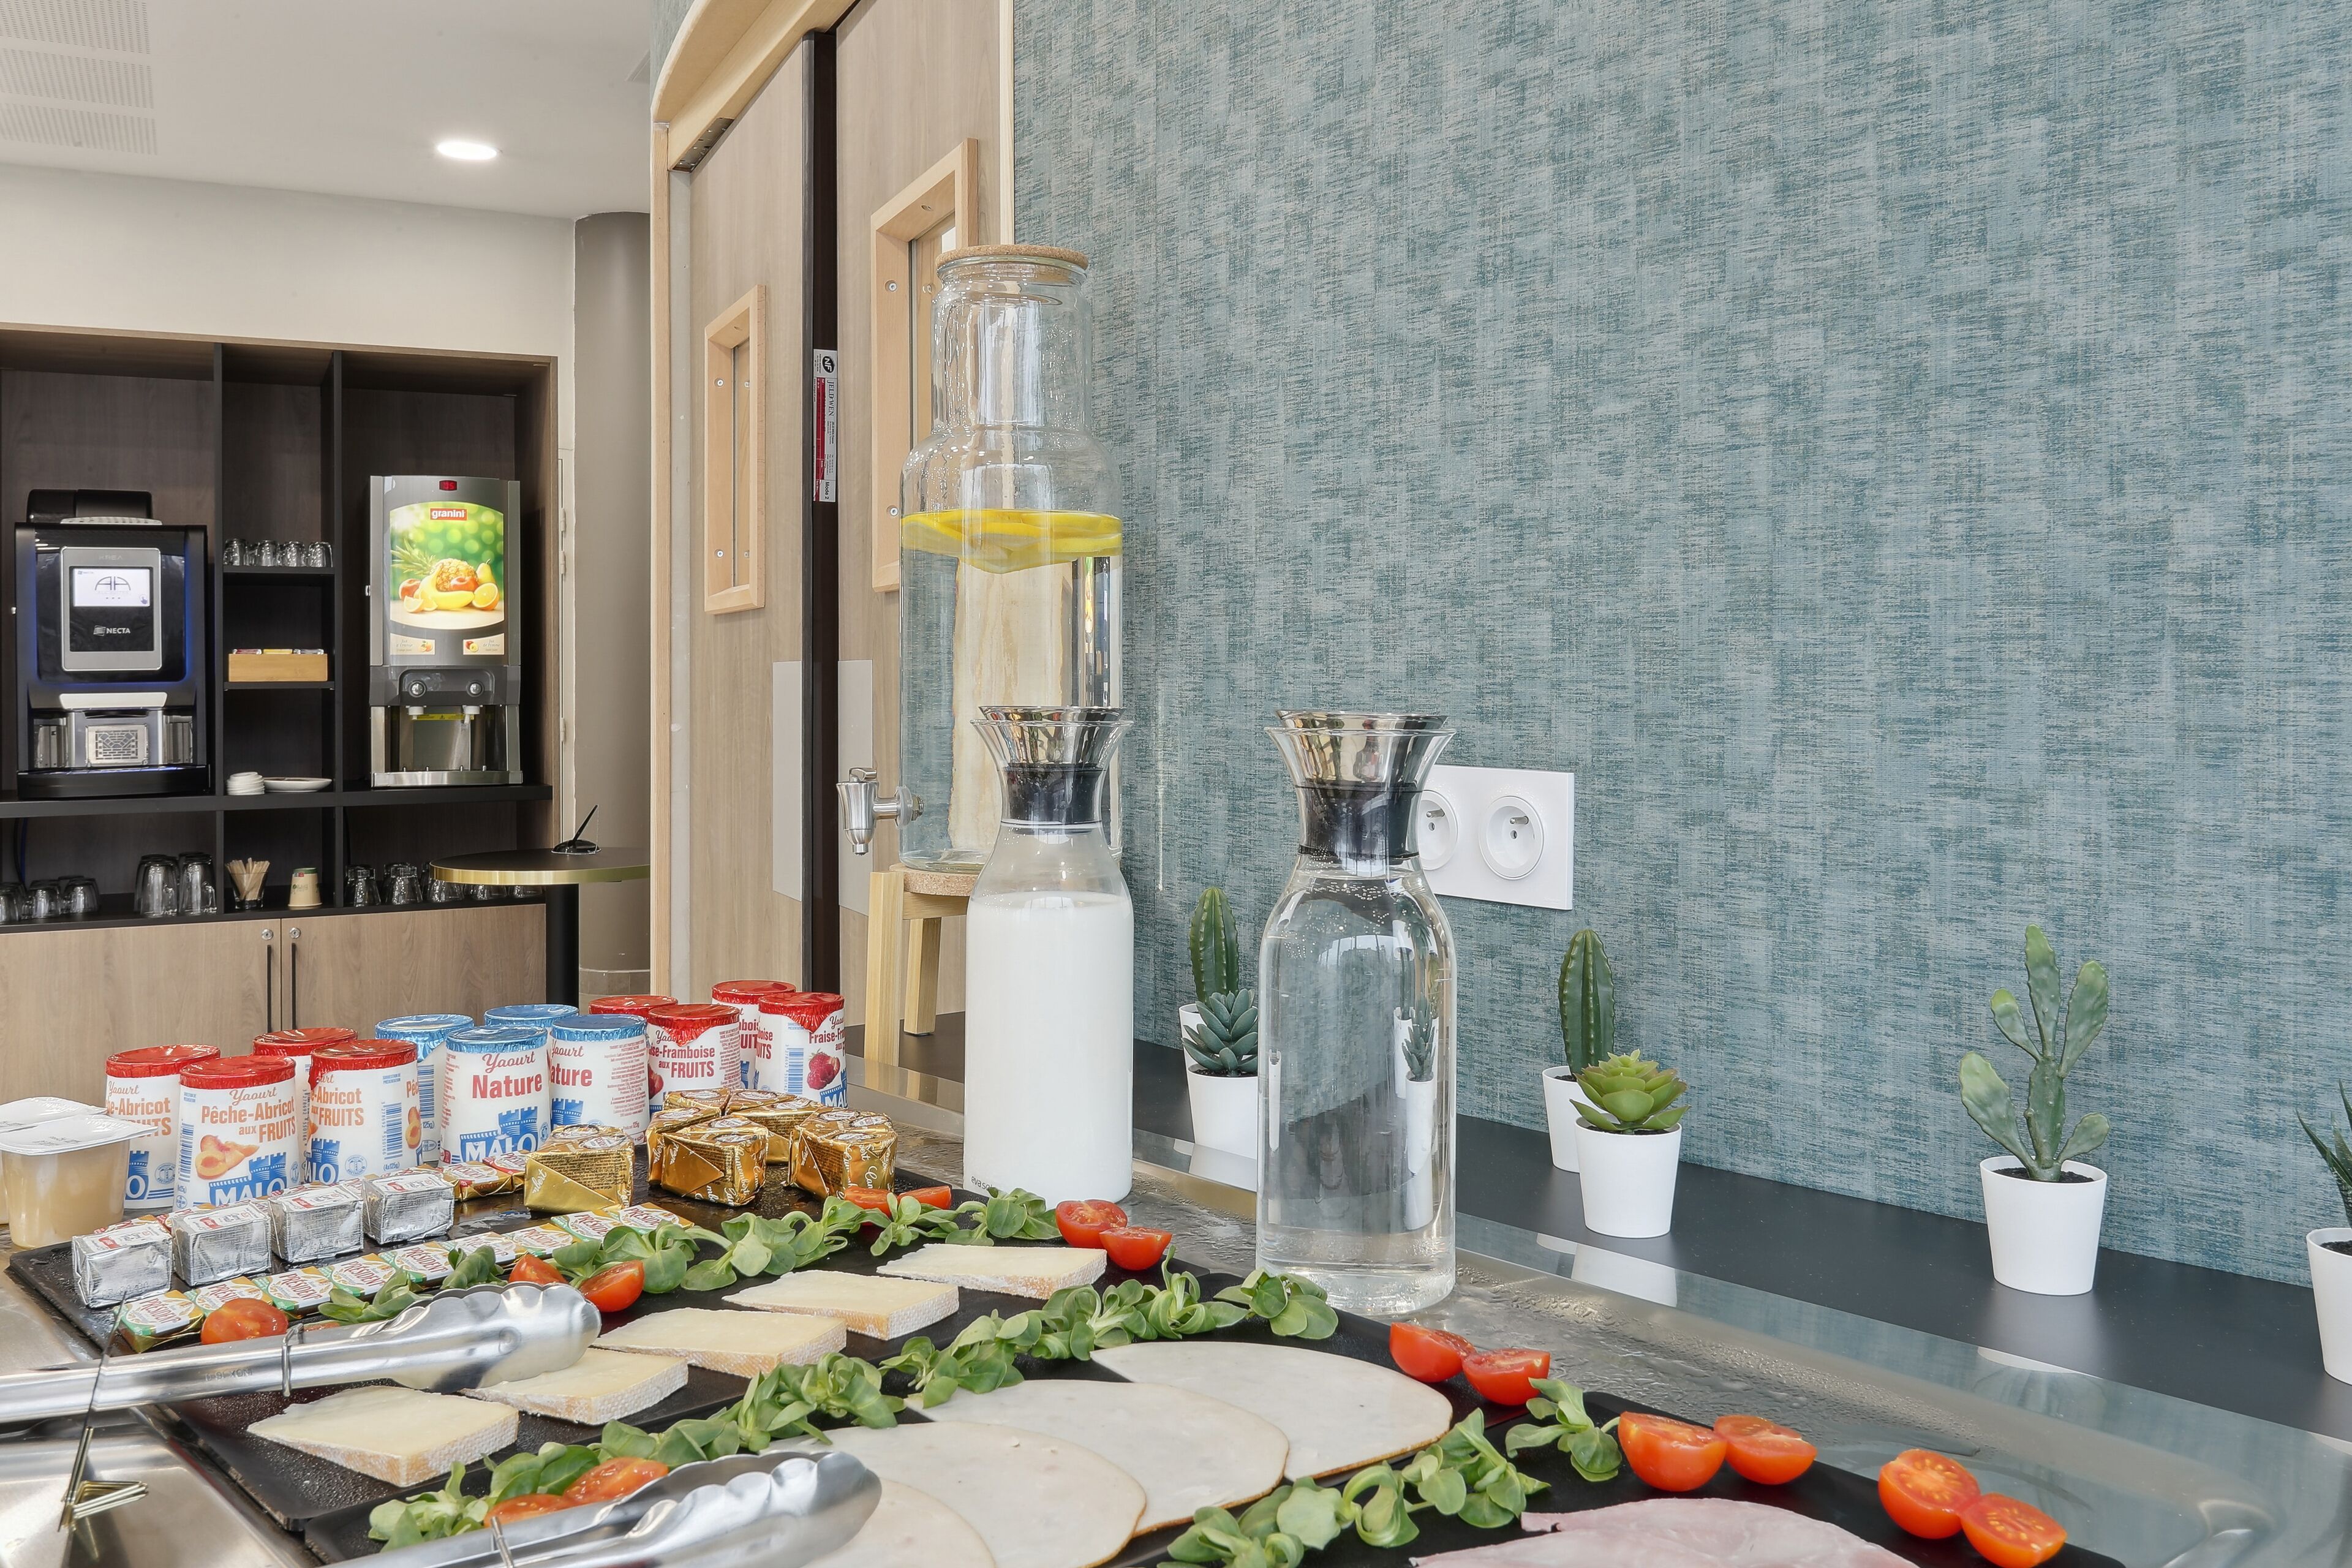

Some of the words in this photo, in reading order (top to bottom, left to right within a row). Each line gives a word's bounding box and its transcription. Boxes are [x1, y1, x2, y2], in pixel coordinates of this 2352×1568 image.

[824, 358, 832, 372] NF
[432, 510, 465, 519] granini
[482, 1051, 536, 1074] Yaourt
[658, 1060, 670, 1069] aux
[671, 1060, 715, 1079] FRUITS
[551, 1063, 593, 1087] ature
[108, 1080, 140, 1097] Yaourt
[472, 1073, 543, 1099] Nature
[229, 1087, 278, 1106] Yaourt
[201, 1096, 295, 1125] Pêche-Abricot
[318, 1107, 364, 1127] FRUITS
[239, 1125, 257, 1136] aux
[258, 1116, 296, 1143] FRUITS
[971, 1176, 982, 1188] eva
